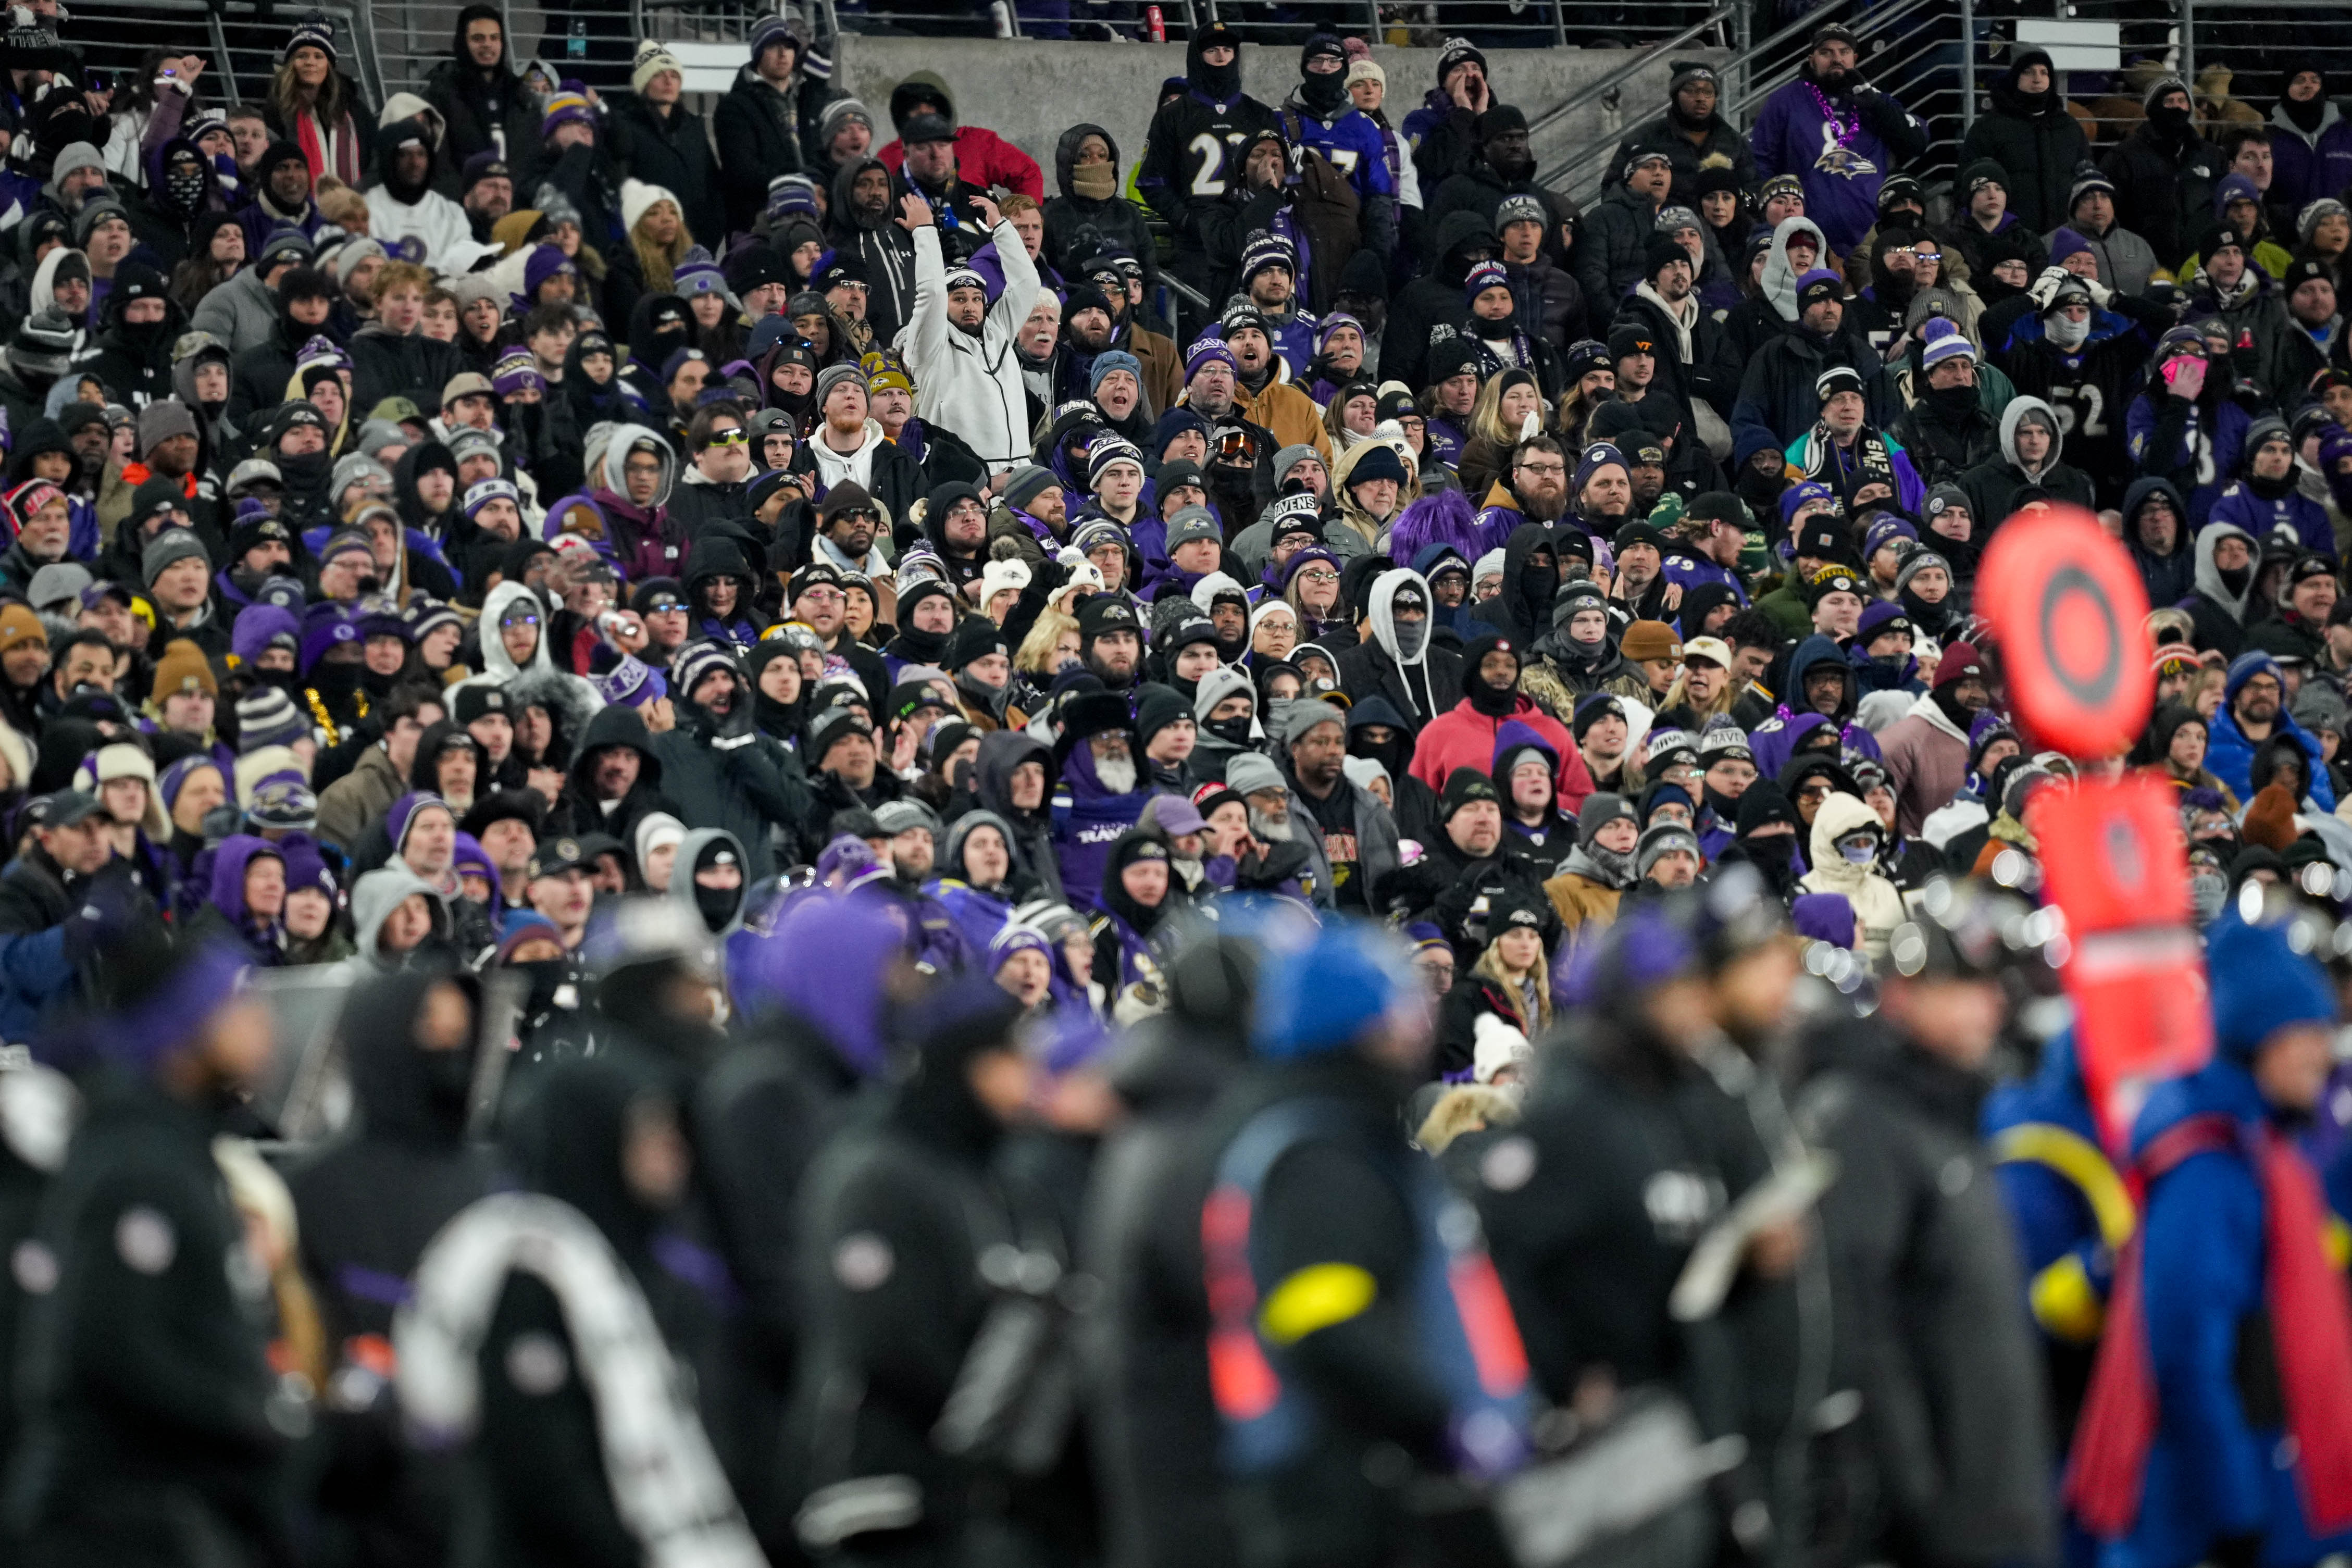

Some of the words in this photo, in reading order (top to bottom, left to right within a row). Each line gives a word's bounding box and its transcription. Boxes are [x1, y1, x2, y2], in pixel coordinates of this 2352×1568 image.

[1189, 133, 1249, 196] 2
[1222, 305, 1259, 325] RAVENS
[1635, 341, 1652, 351] VT
[2051, 384, 2107, 437] 52
